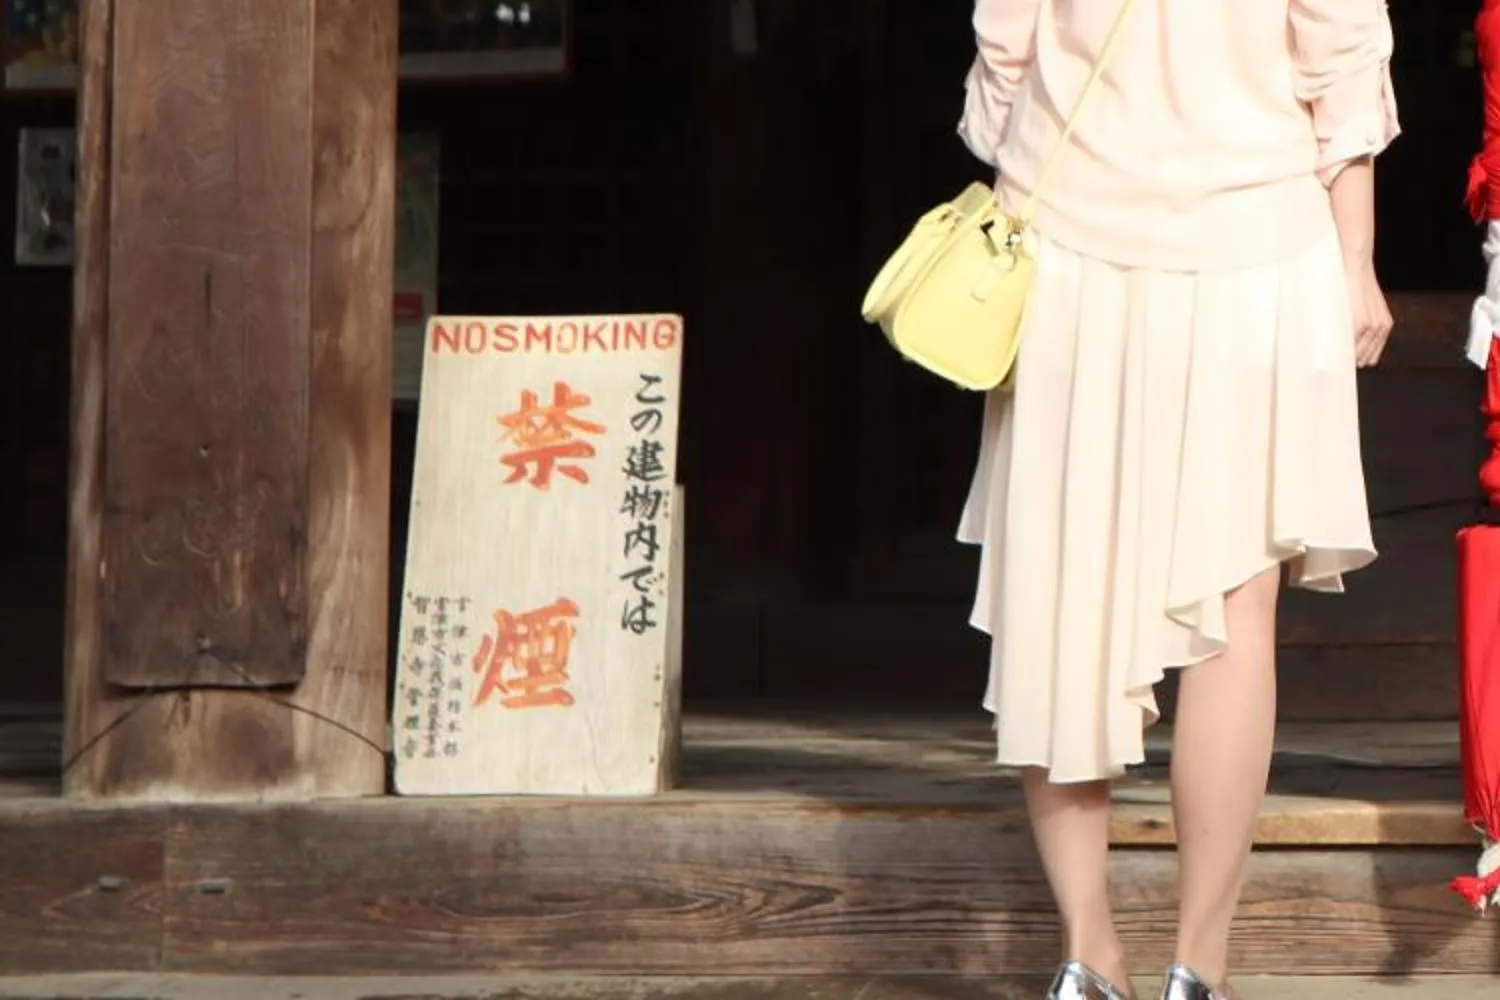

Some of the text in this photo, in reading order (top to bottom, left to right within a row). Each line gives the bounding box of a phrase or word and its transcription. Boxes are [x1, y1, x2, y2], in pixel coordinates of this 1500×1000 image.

[472, 380, 607, 711] 禁煙
[618, 372, 669, 636] この建物内では
